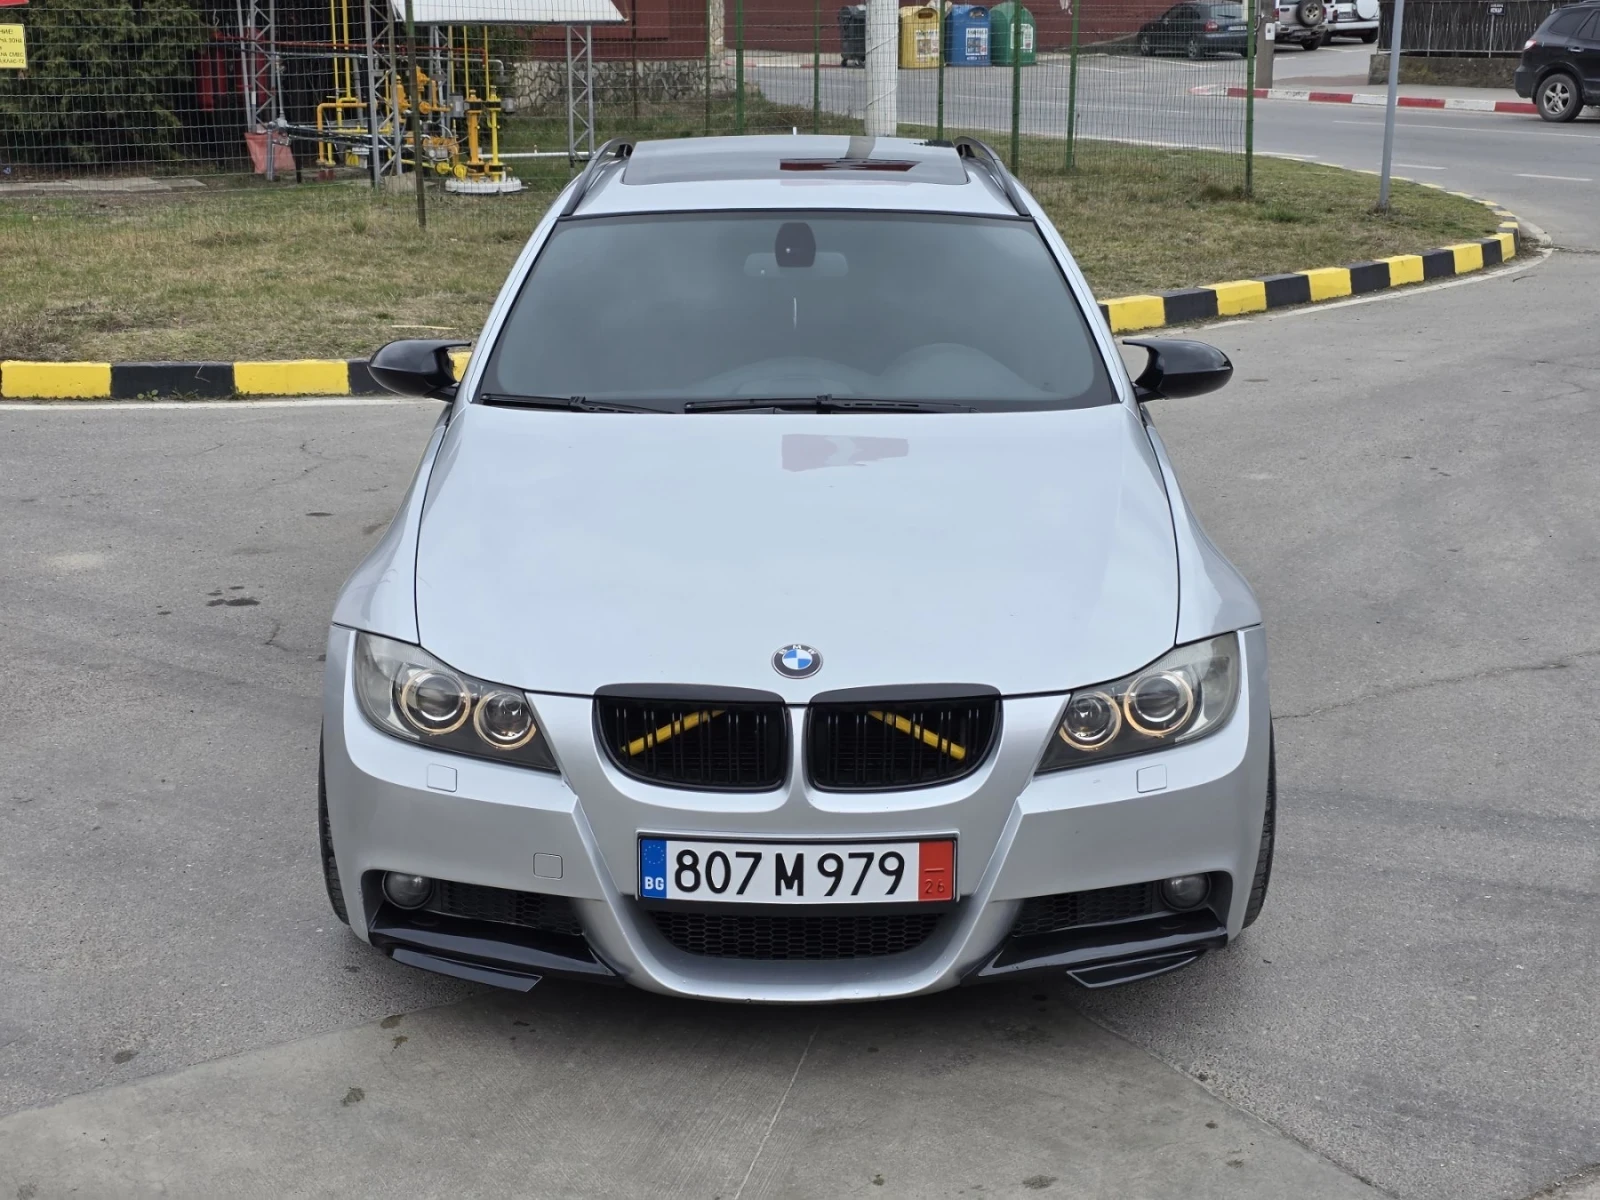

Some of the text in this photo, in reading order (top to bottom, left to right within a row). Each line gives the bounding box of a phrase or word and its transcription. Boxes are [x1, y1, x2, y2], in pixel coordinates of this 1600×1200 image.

[674, 849, 905, 897] 807 M 979
[644, 876, 664, 890] BG
[923, 878, 945, 893] 26
